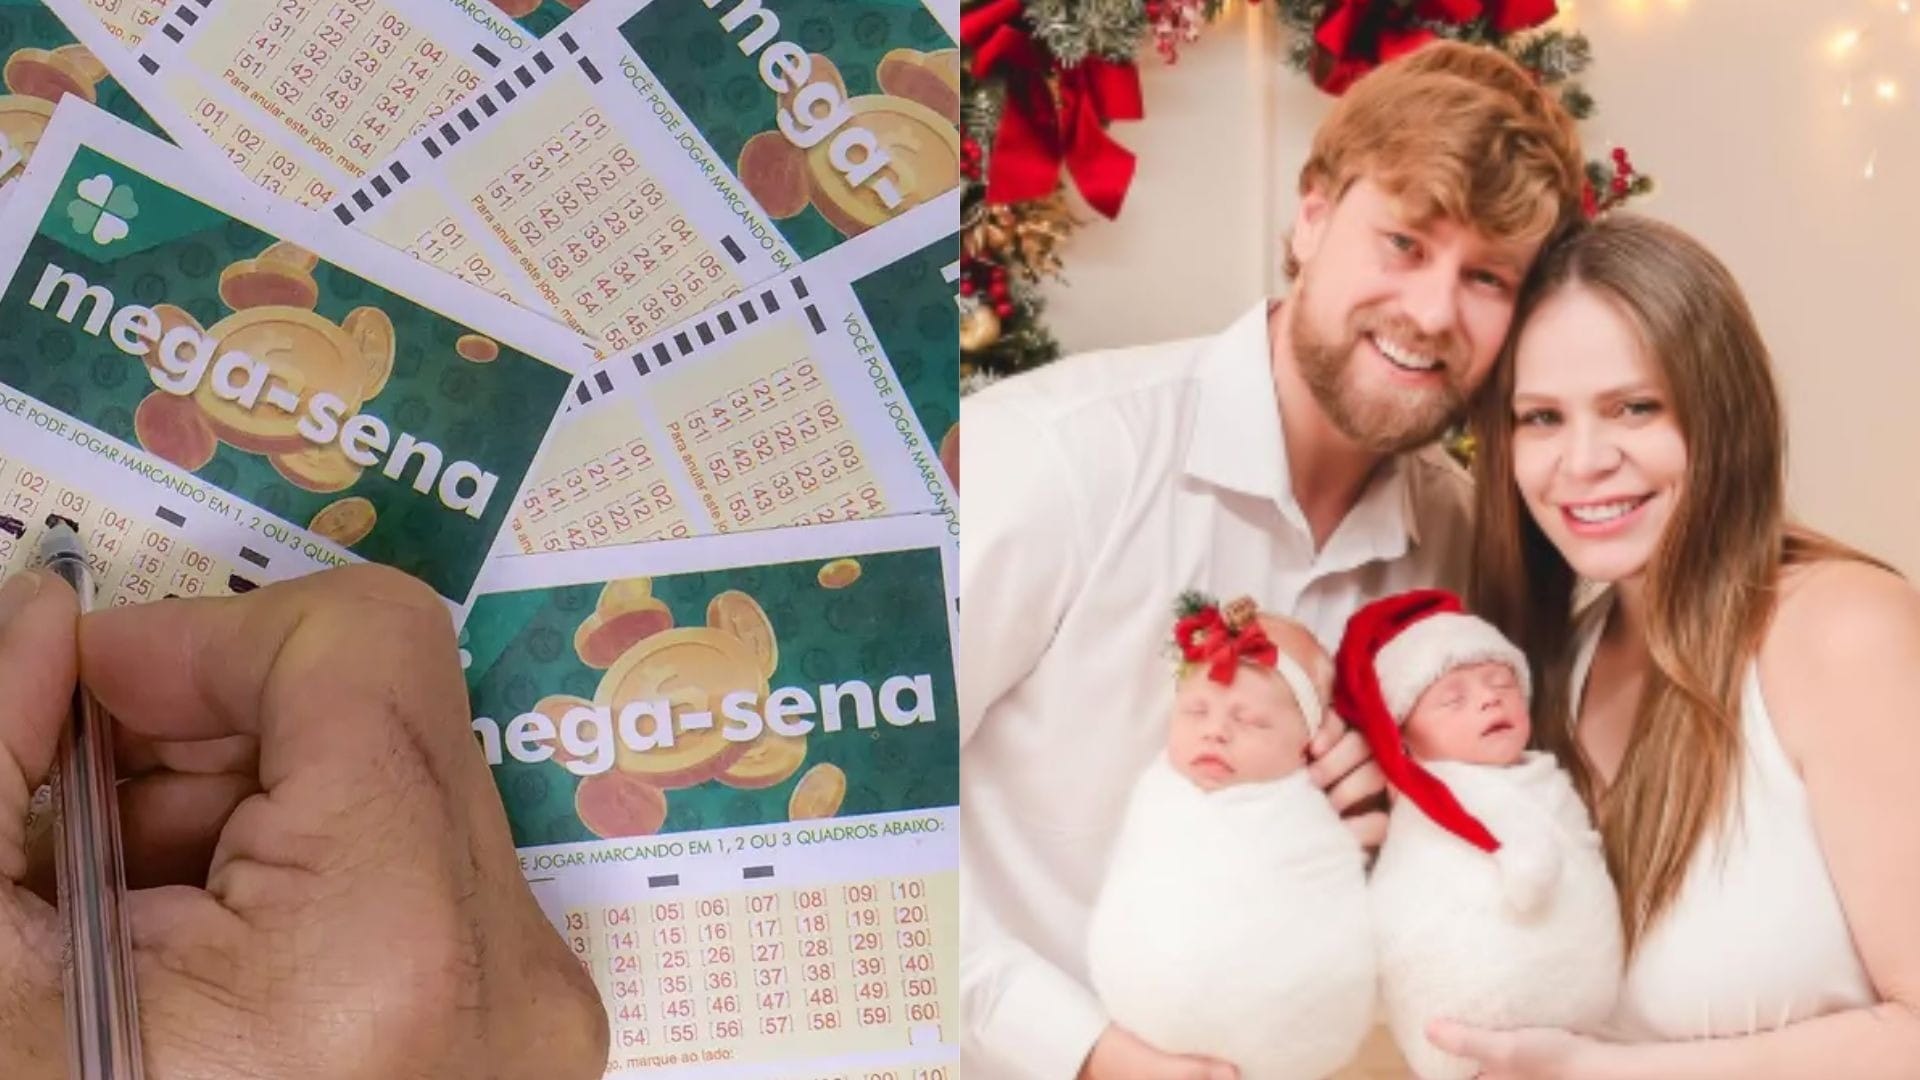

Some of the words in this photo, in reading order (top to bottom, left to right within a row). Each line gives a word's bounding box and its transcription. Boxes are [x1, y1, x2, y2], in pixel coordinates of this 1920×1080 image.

[223, 69, 250, 92] Para
[250, 90, 284, 118] anular
[284, 116, 309, 137] este
[619, 56, 654, 95] VOCÊ
[647, 94, 680, 132] PODE
[674, 132, 715, 176] JOGAR
[710, 176, 774, 250] MARCANDO
[771, 250, 792, 272] EM
[472, 194, 494, 223] Para
[492, 224, 522, 256] anular
[519, 257, 540, 281] este
[28, 262, 499, 518] mega-sena
[842, 312, 875, 356] VOCÊ
[865, 357, 893, 400] PODE
[884, 400, 918, 451] JOGAR
[27, 407, 68, 437] PODE
[68, 430, 120, 463] JOGAR
[120, 452, 206, 503] MARCANDO
[208, 496, 230, 516] EM
[249, 517, 260, 530] 2
[263, 523, 289, 544] OU
[290, 536, 301, 550] 3
[666, 421, 686, 452] Para
[702, 492, 722, 520] este
[532, 854, 585, 871] JOGAR
[589, 843, 684, 864] MARCANDO
[689, 840, 712, 855] EM
[718, 838, 731, 854] 1,
[735, 836, 745, 850] 2
[750, 834, 776, 848] OU
[782, 832, 791, 846] 3
[796, 824, 878, 845] QUADROS
[882, 818, 945, 837] ABAIXO:
[627, 1054, 677, 1068] marque
[681, 1054, 698, 1063] ao
[702, 1048, 735, 1060] lado:
